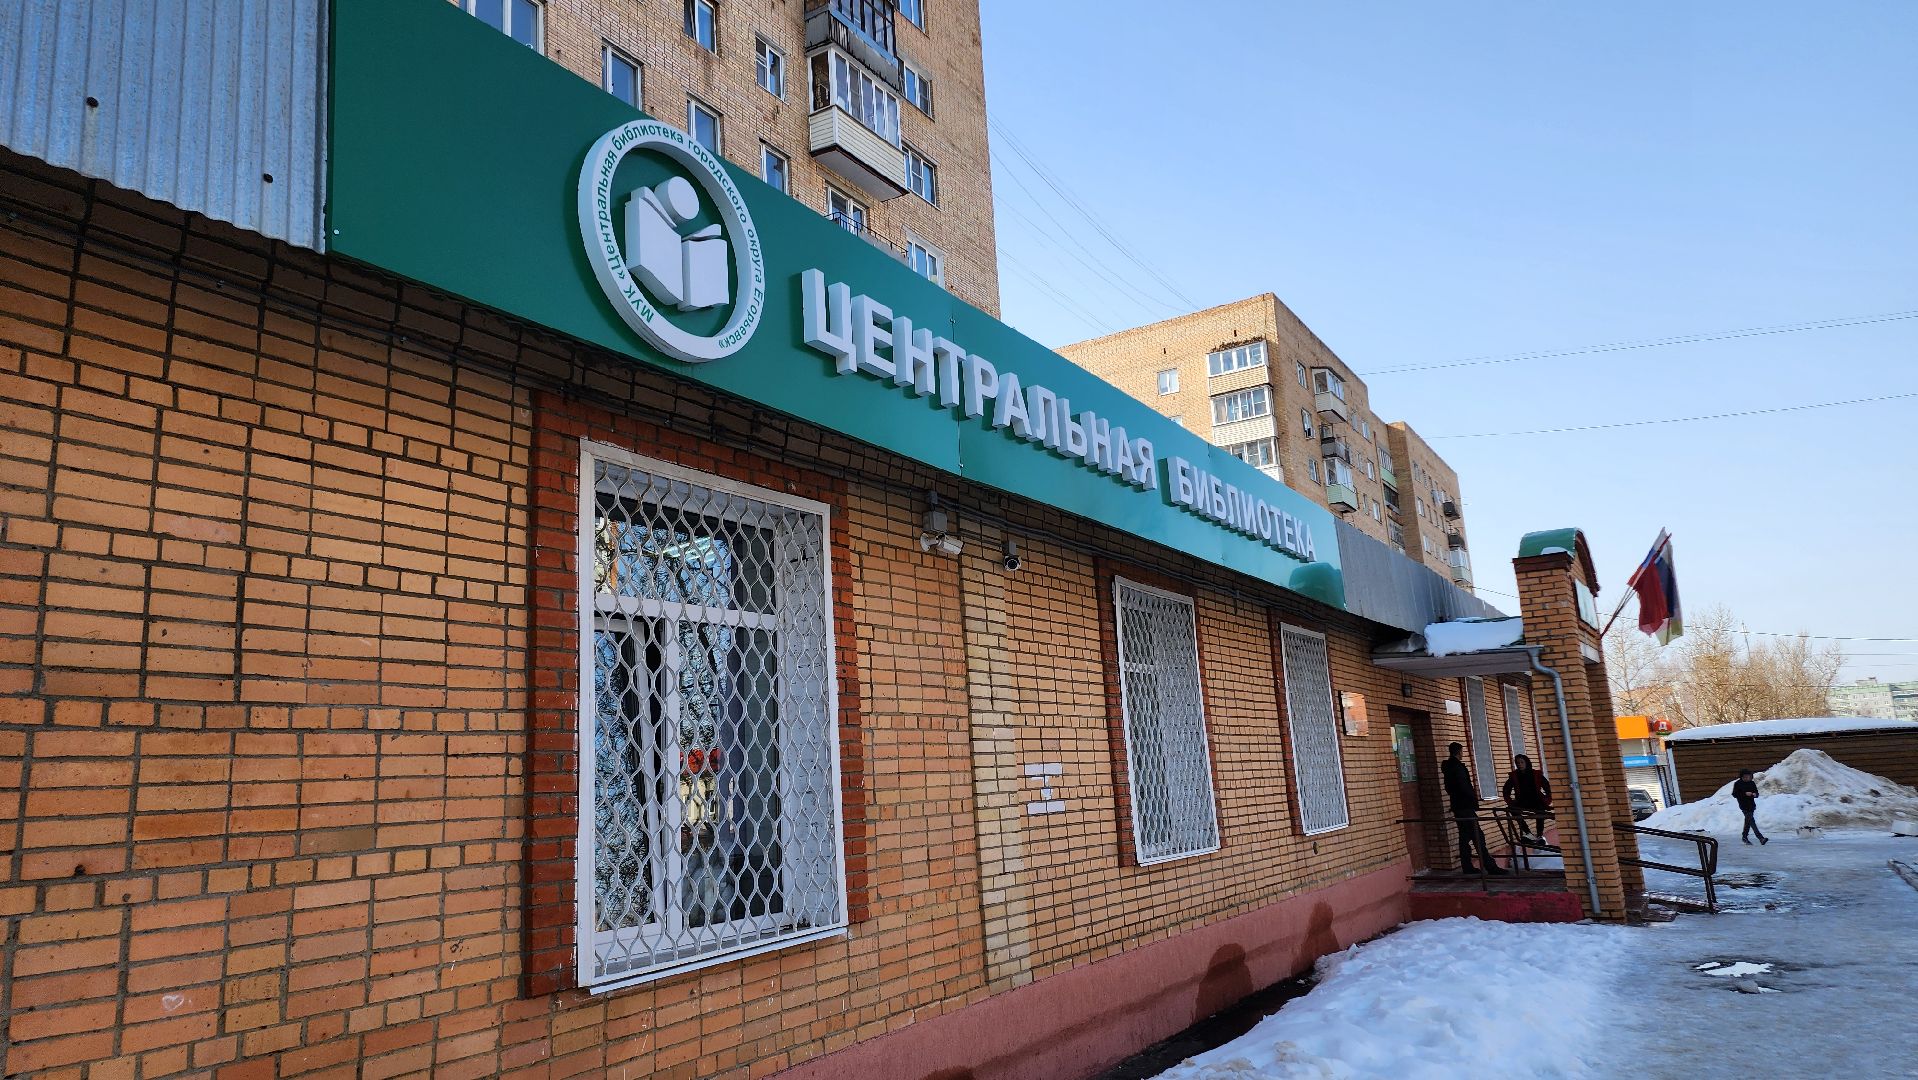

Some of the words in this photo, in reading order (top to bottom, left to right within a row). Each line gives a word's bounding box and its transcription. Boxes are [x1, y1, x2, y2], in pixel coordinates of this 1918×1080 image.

[613, 125, 684, 151] библиотека
[688, 140, 747, 223] городского
[594, 151, 627, 280] «Центральная
[747, 229, 762, 283] округа
[623, 286, 655, 324] МУК
[718, 289, 764, 349] Егорьевск»
[802, 268, 1157, 490] ЦЕНТРАЛЬНАЯ
[1167, 456, 1317, 563] БИБЛИОТЕКА
